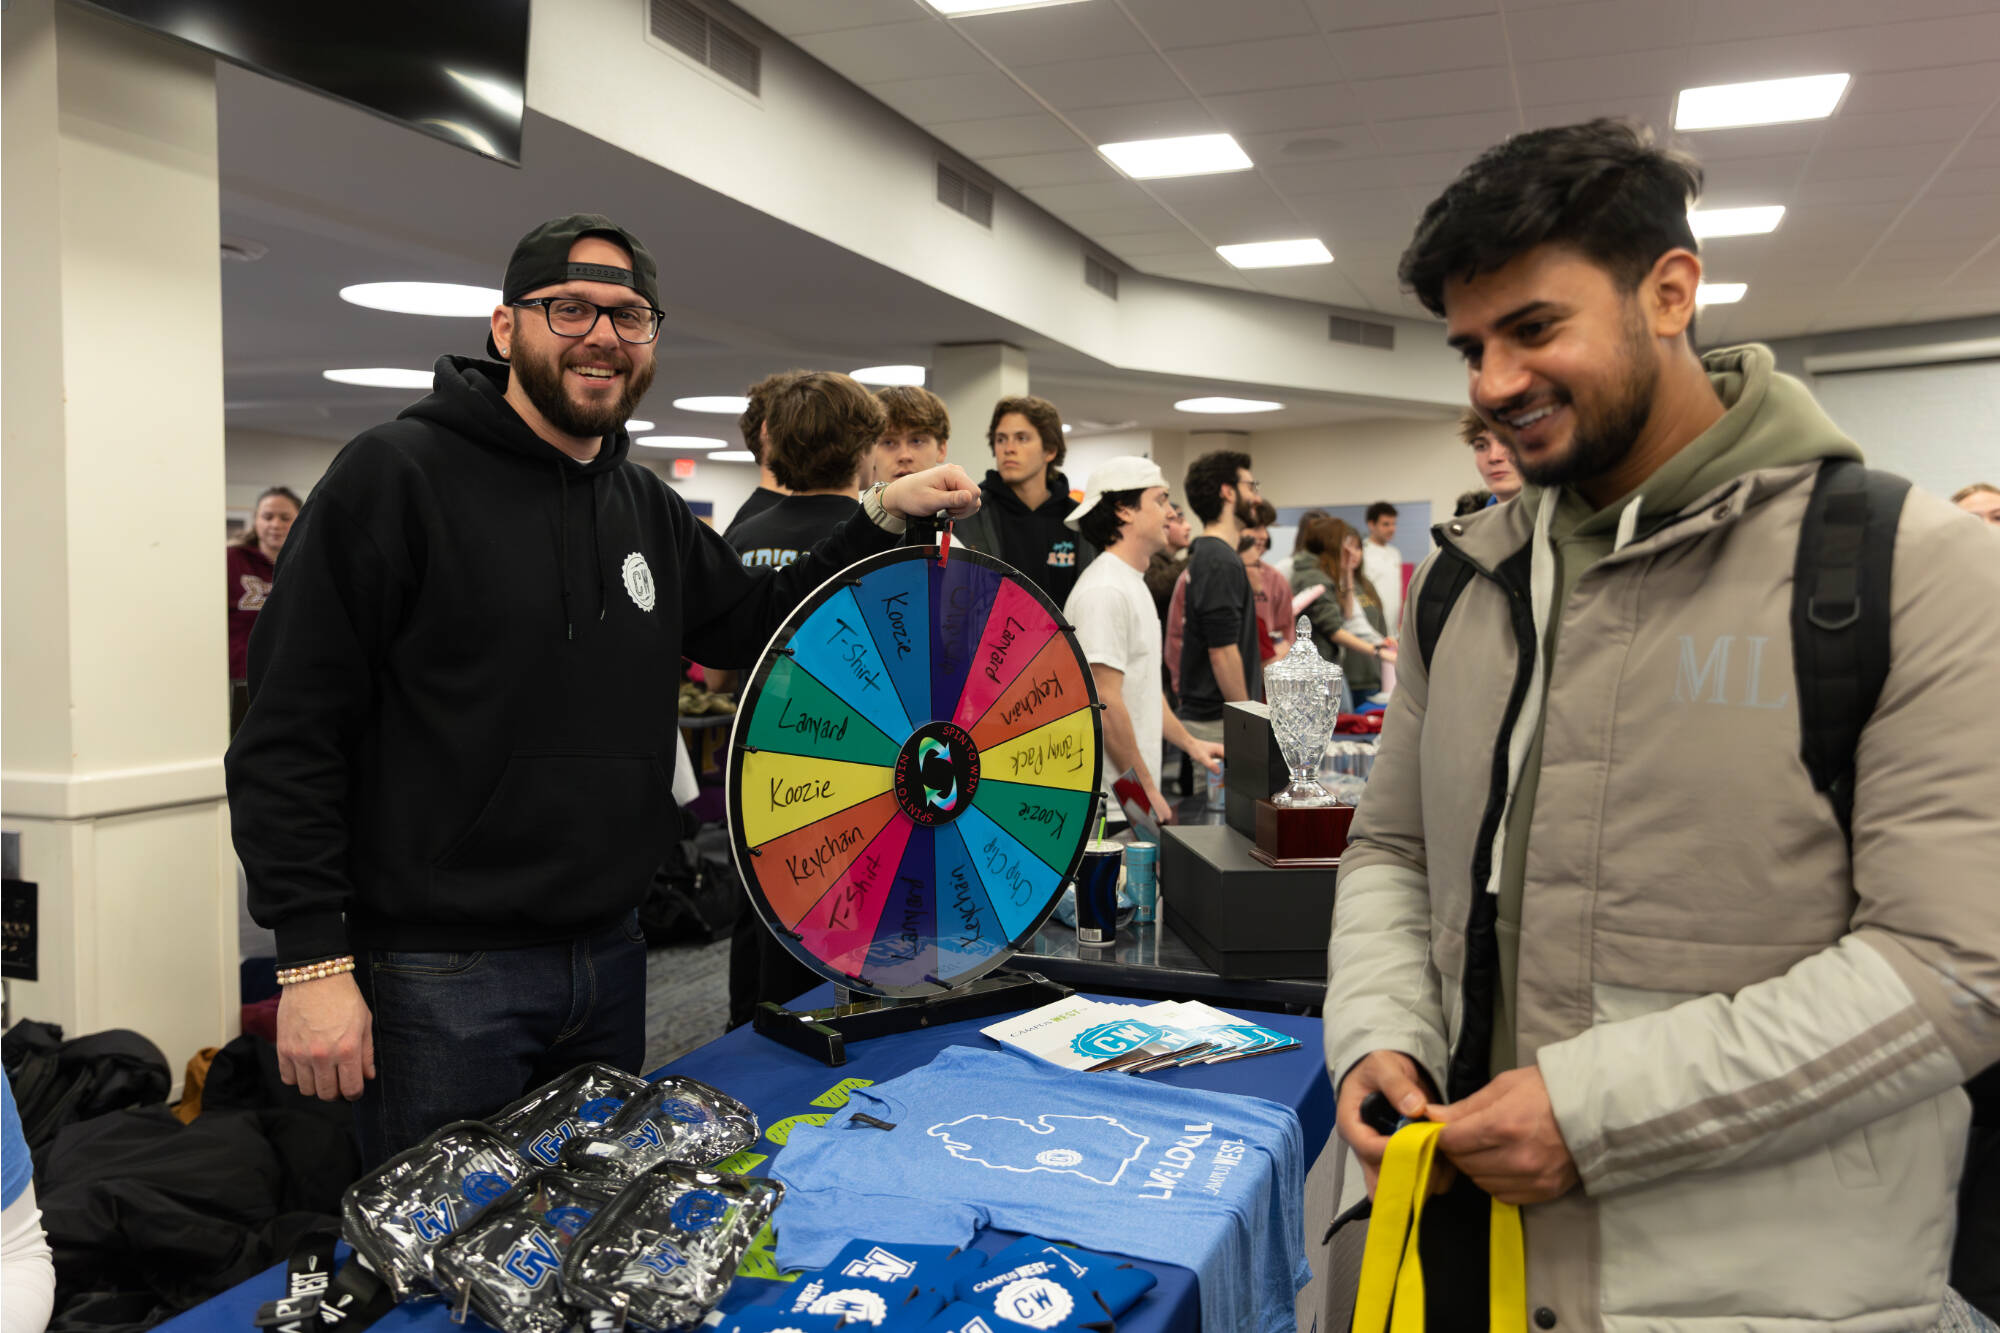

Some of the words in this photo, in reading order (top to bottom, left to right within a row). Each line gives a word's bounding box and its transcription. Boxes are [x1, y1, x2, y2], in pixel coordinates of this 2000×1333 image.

[880, 591, 912, 662] Koozie
[826, 617, 881, 692] T-Shirt
[985, 616, 1025, 685] Lanyard
[1671, 633, 1790, 710] ML
[1000, 669, 1064, 726] Keychain
[778, 698, 849, 745] Lanyard
[943, 726, 969, 745] SPIN
[896, 752, 911, 784] WIN
[966, 743, 977, 761] TO
[1010, 746, 1043, 776] Pack
[770, 776, 836, 813] Koozie
[897, 787, 909, 805] TO
[966, 764, 979, 794] WIN
[907, 803, 934, 823] SPIN
[1018, 801, 1068, 841] Koozie
[785, 826, 864, 886] Keychain
[983, 837, 1008, 876] Clip
[828, 853, 881, 930] T-Shirt
[1005, 859, 1033, 907] Chip
[890, 875, 928, 960] Lanyard
[950, 863, 985, 948] Keychain
[1093, 1024, 1150, 1052] CW
[1158, 1122, 1214, 1170] LOCAL
[1138, 1168, 1185, 1200] LIVE
[501, 1226, 562, 1291] GV
[973, 1270, 1019, 1293] CAMPUS
[1014, 1261, 1050, 1279] WEST
[1013, 1287, 1054, 1319] CW
